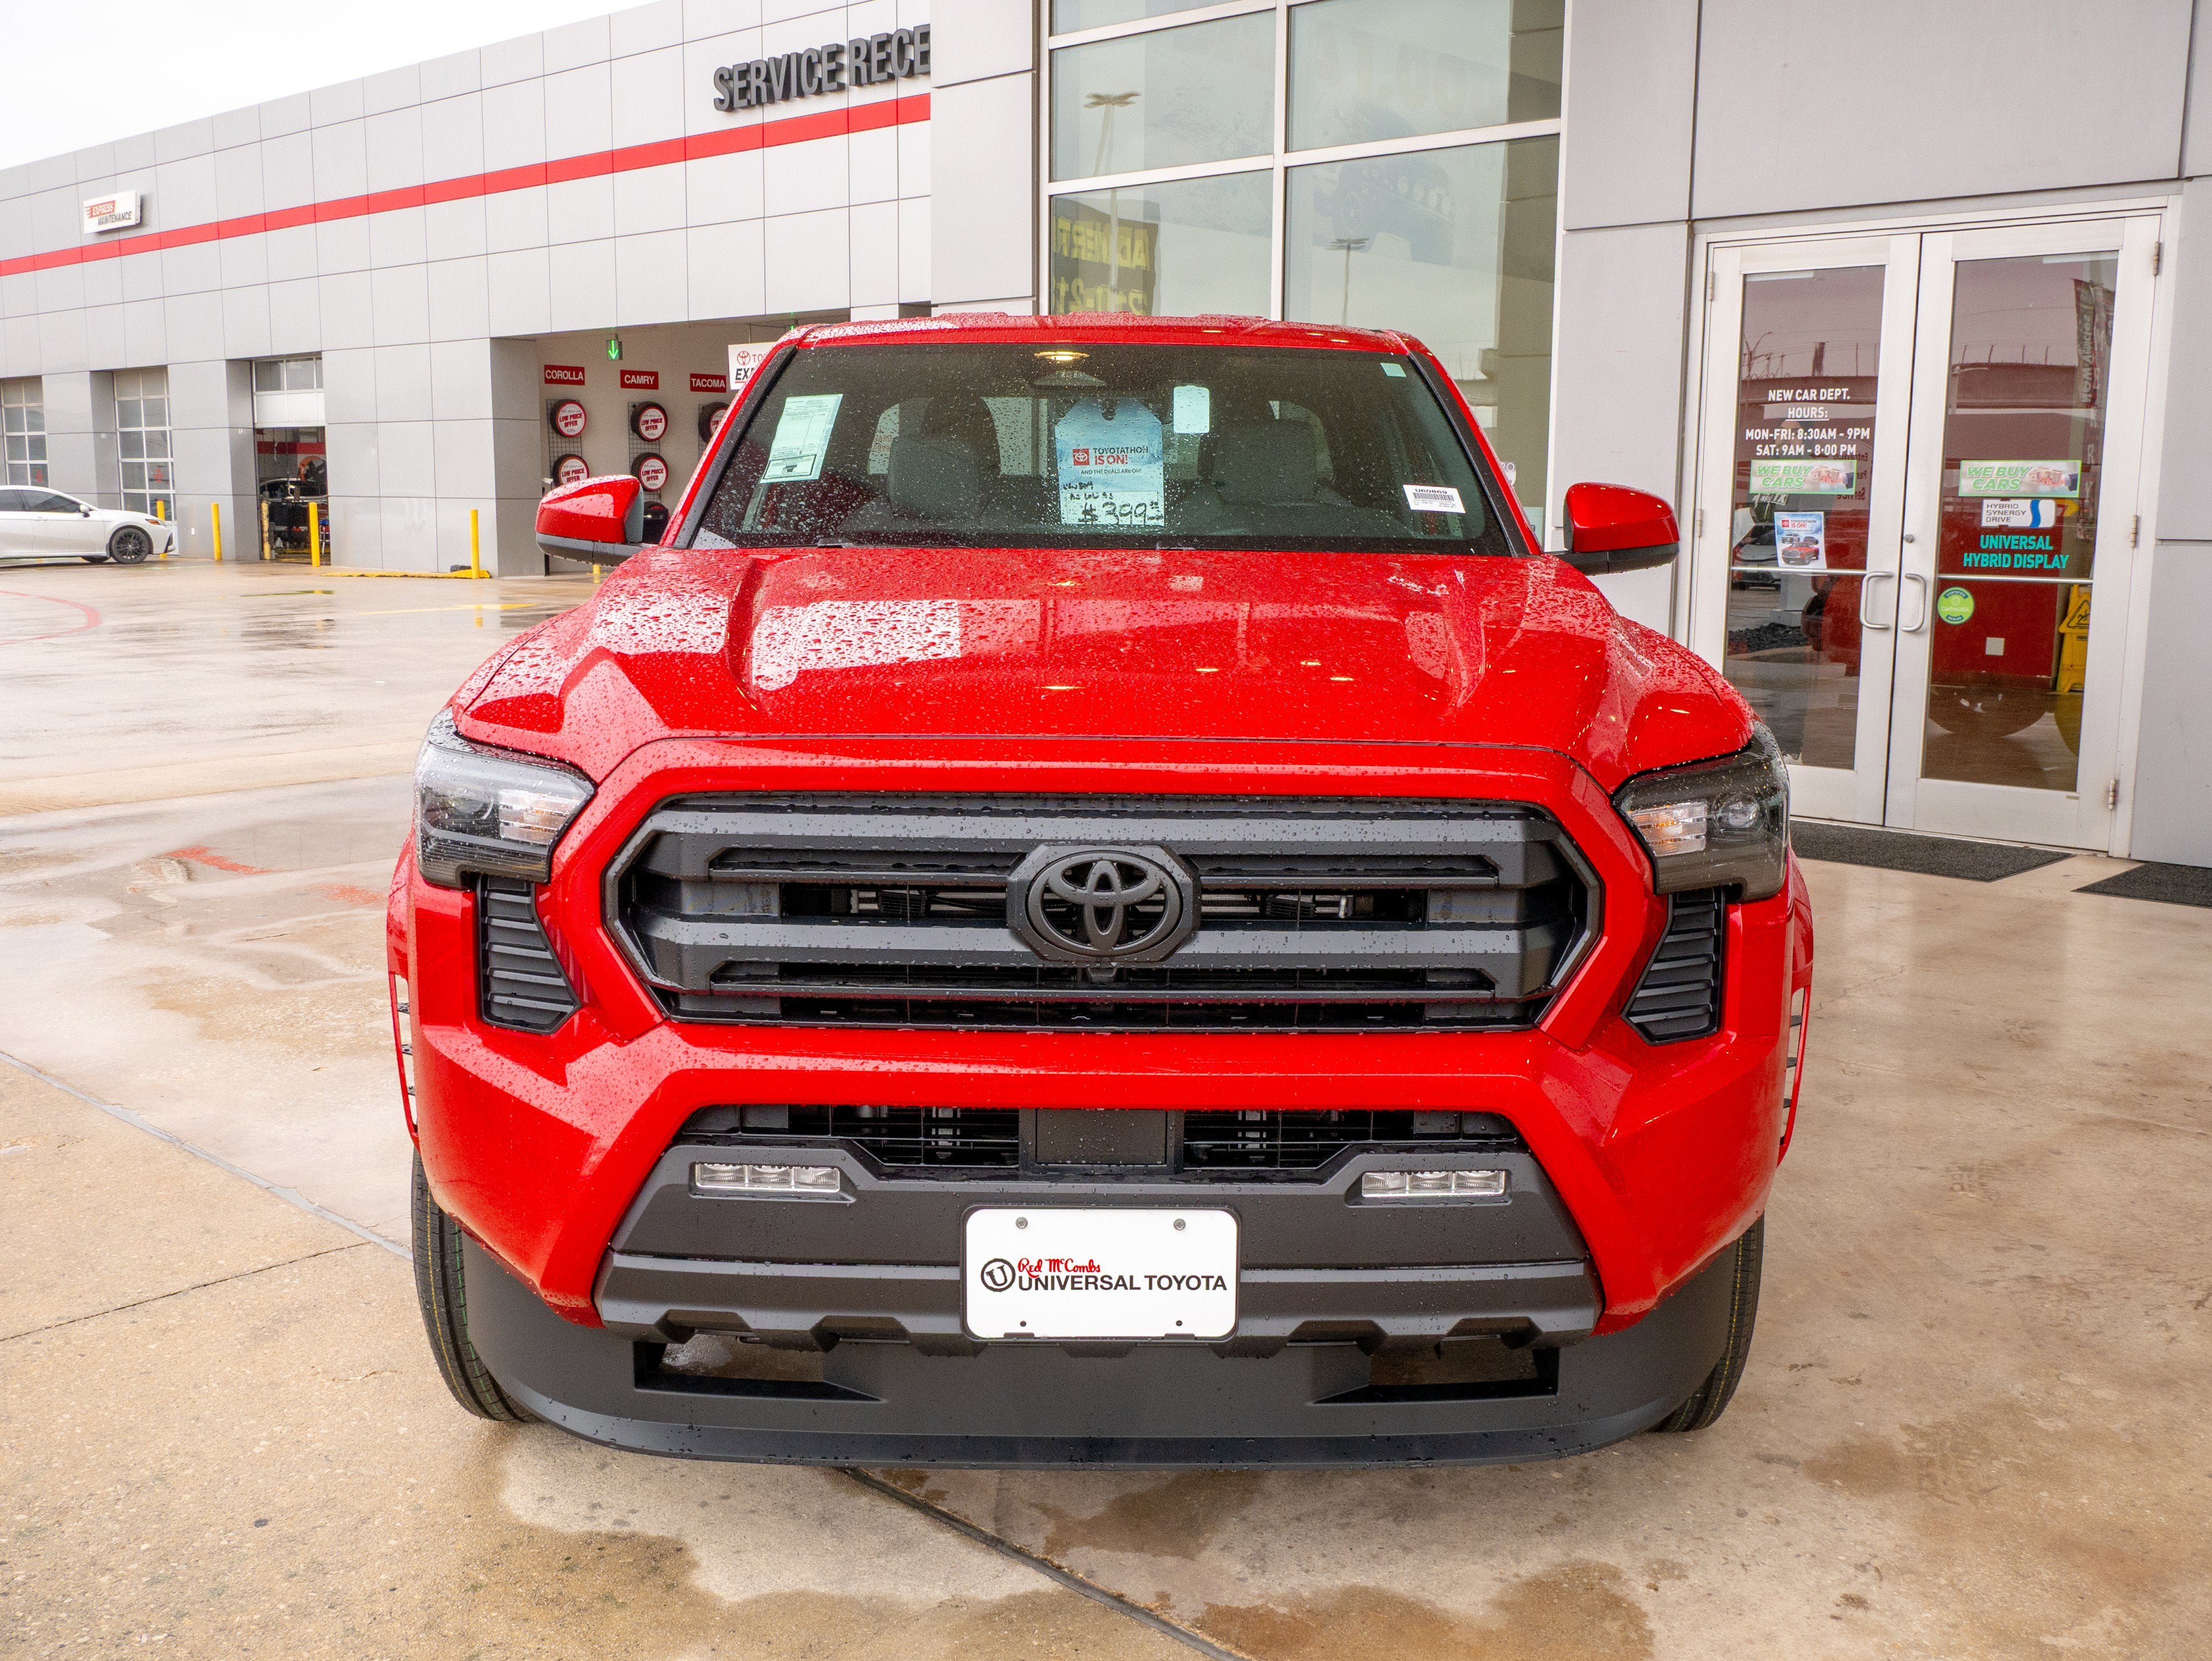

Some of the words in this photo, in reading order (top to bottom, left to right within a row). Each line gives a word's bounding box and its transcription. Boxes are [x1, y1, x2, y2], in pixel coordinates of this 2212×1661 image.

[714, 43, 846, 112] SERVICE
[849, 24, 930, 86] RECE
[97, 211, 132, 225] MAINTENANCE
[752, 354, 764, 363] TO
[545, 369, 584, 381] COROLLA
[624, 374, 654, 385] CAMRY
[691, 378, 725, 388] TACOMA
[1768, 389, 1793, 401] NEW
[1796, 389, 1817, 400] CAR
[1820, 388, 1850, 400] DEPT.
[1788, 407, 1828, 418] HOURS:
[1745, 428, 1795, 440] MON-FRI:
[1797, 428, 1836, 440] 8:30AM
[1847, 427, 1870, 440] 9PM
[1093, 446, 1149, 455] TOYOTATHON
[1756, 444, 1779, 456] SAT:
[1782, 444, 1804, 456] 9AM
[1839, 444, 1856, 456] PM
[1094, 455, 1104, 465] IS
[1107, 455, 1128, 465] ON!
[1757, 466, 1780, 476] WE
[1782, 465, 1813, 476] BUY
[1967, 467, 1994, 478] WE
[1996, 466, 2032, 478] BUY
[1762, 477, 1805, 489] CARS
[1972, 479, 2021, 490] CARS
[1980, 535, 2053, 550] UNIVERSAL
[1963, 553, 2011, 567] HYBRID
[2014, 554, 2069, 569] DISPLAY
[1018, 1258, 1042, 1278] Red
[1045, 1258, 1100, 1273] McCombs
[1018, 1275, 1141, 1291] UNIVERSAL
[1145, 1275, 1227, 1291] TOYOTA
